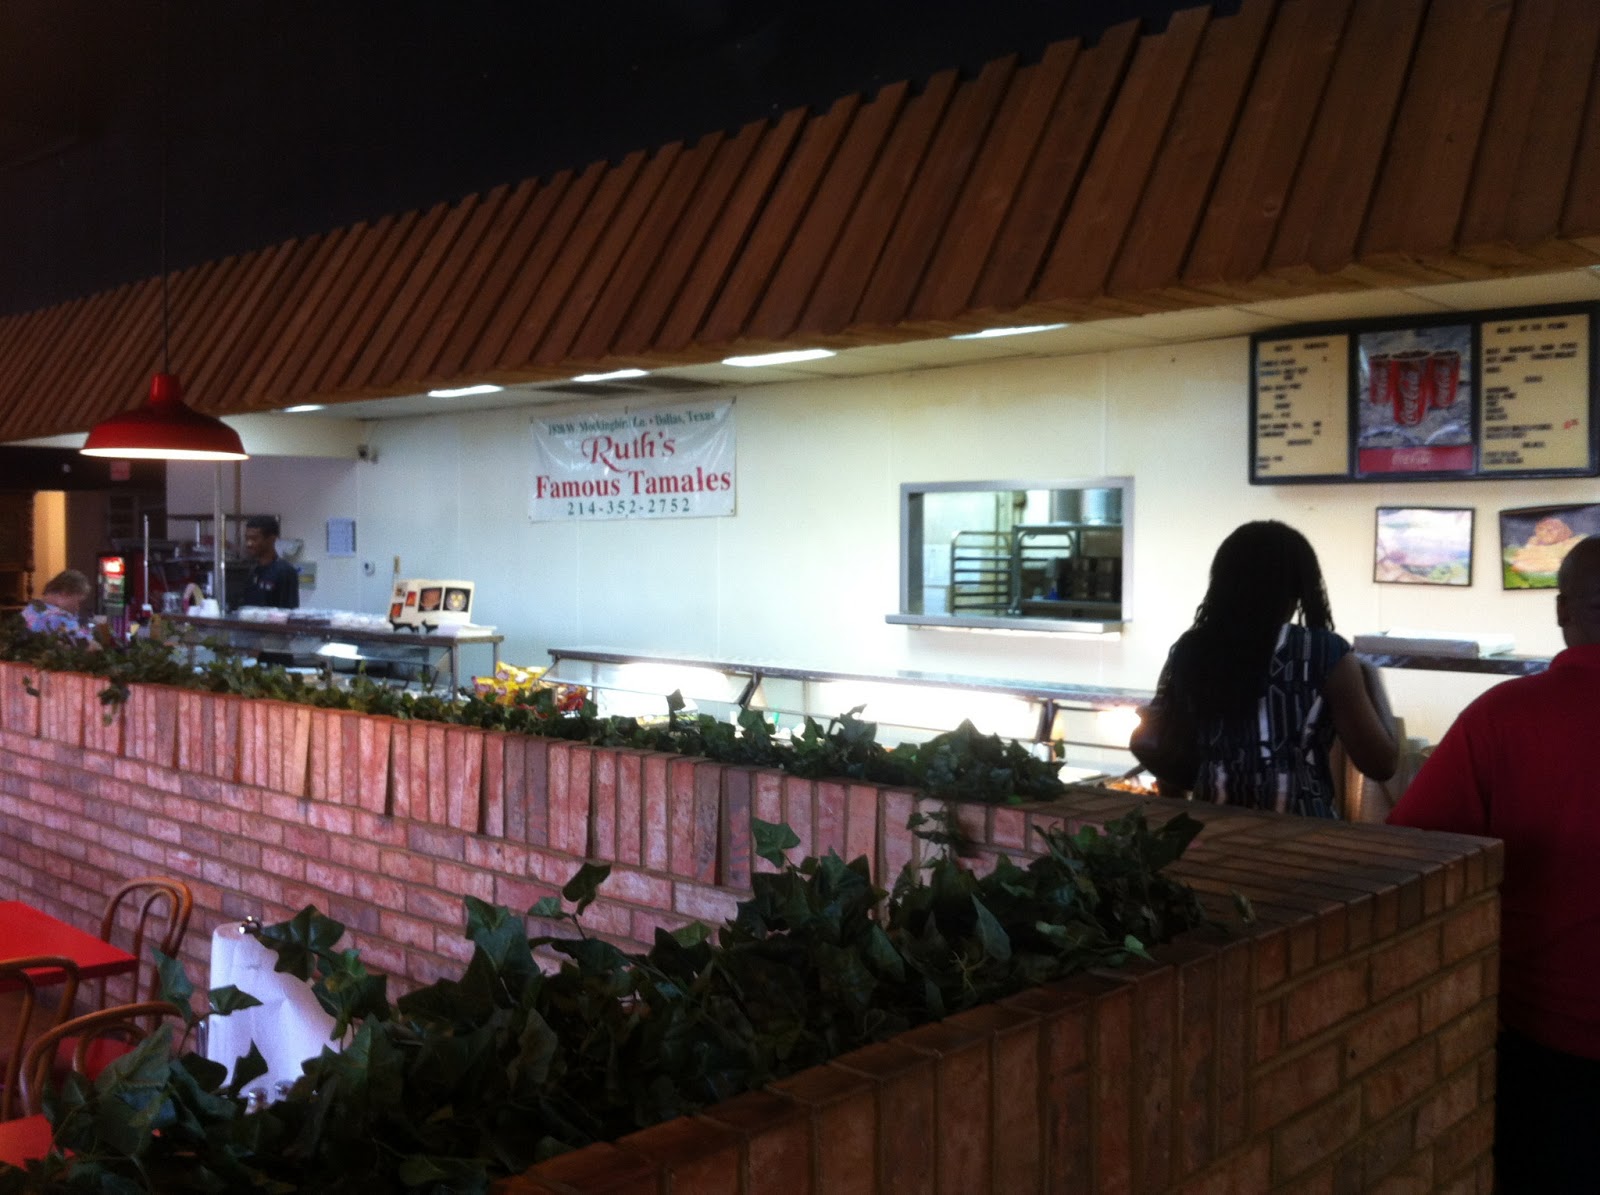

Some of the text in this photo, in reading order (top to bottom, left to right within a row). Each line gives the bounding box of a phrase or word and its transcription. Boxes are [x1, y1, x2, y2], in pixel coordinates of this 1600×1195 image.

[655, 413, 685, 426] Dallas,
[686, 410, 715, 422] Texas
[581, 431, 675, 473] Ruth's
[536, 466, 731, 499] Famous Tamales
[567, 497, 690, 515] 214-352-2752
